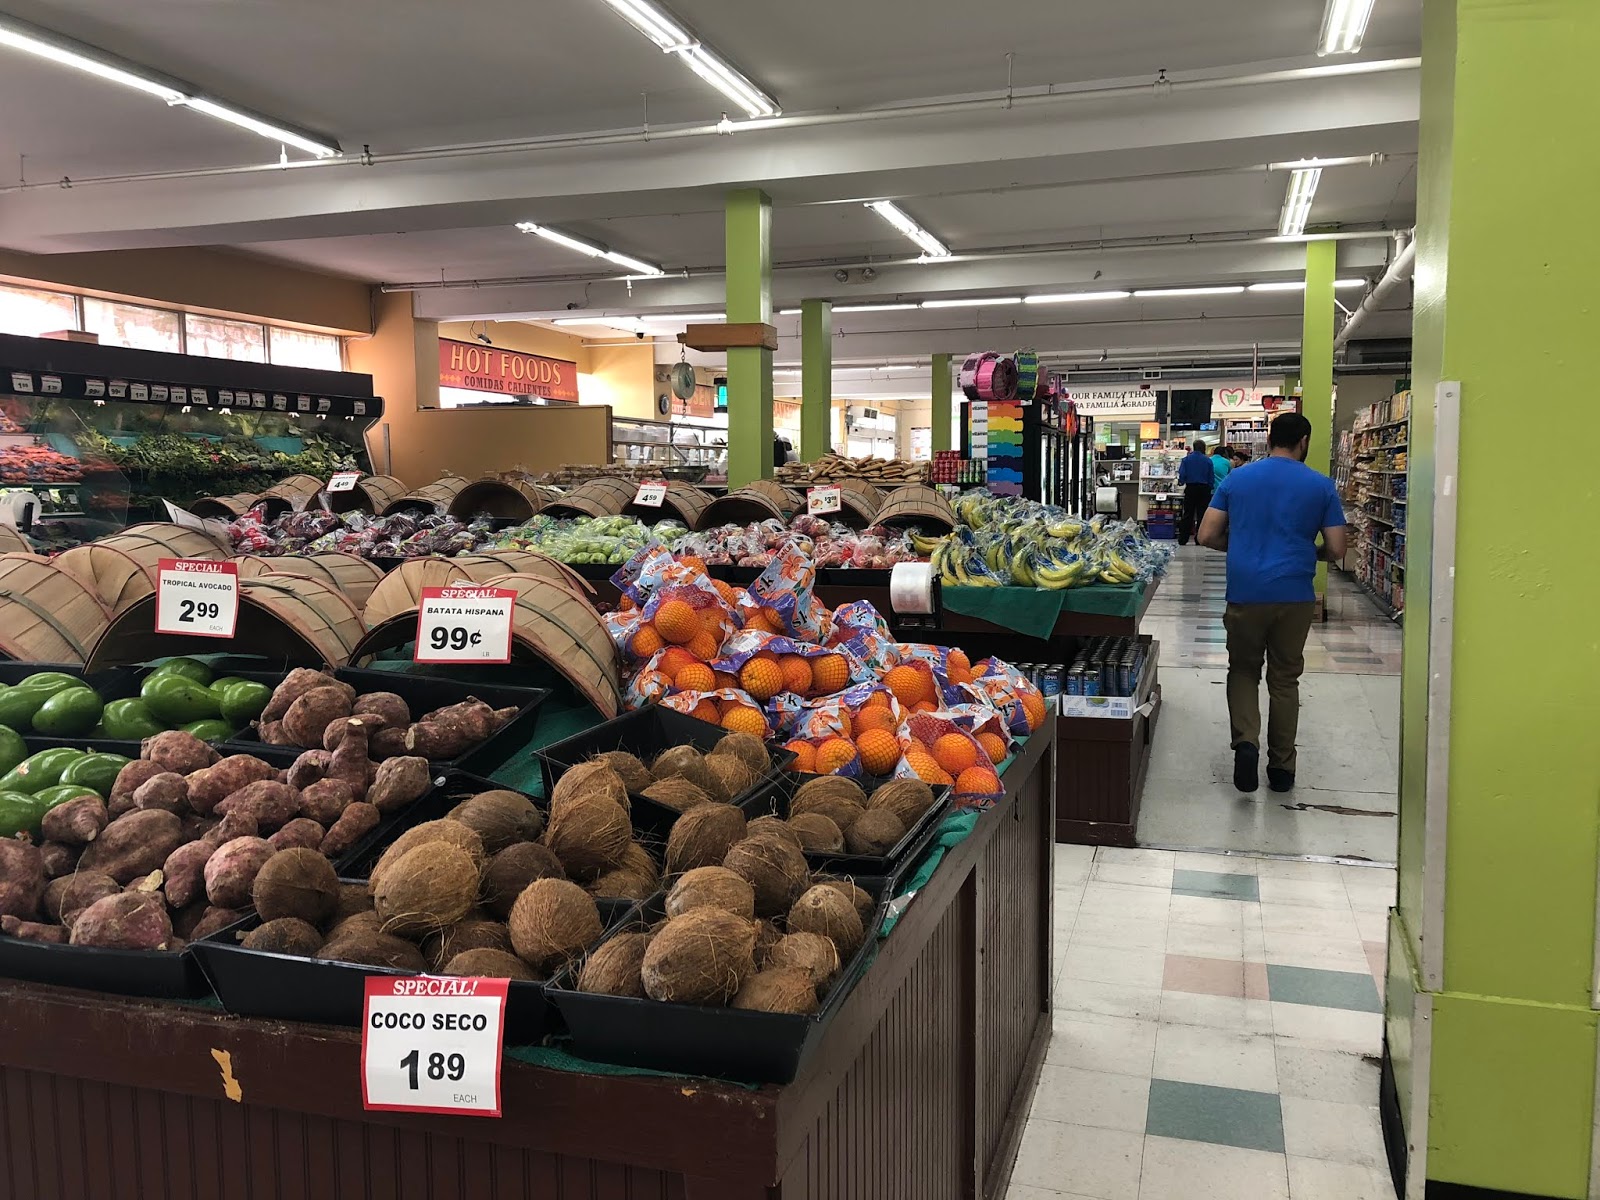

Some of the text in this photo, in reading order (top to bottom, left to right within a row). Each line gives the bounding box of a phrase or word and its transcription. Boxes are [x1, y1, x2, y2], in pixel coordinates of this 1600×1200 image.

[450, 344, 562, 386] HOT FOODS
[464, 375, 551, 397] COMIDAS CALIENTES
[1071, 392, 1090, 400] OUR
[1092, 391, 1127, 399] FAMILY
[1086, 401, 1119, 409] FAMILIA
[642, 494, 658, 502] 459
[174, 561, 223, 574] SPECIAL!
[162, 579, 232, 591] TROPICAL AVOCADO
[440, 588, 498, 599] SPECIAL!
[427, 607, 505, 616] BATATA HISPANA
[392, 979, 479, 996] SPECIAL!
[371, 1012, 487, 1031] COCO SECO
[453, 1094, 477, 1103] EACH
